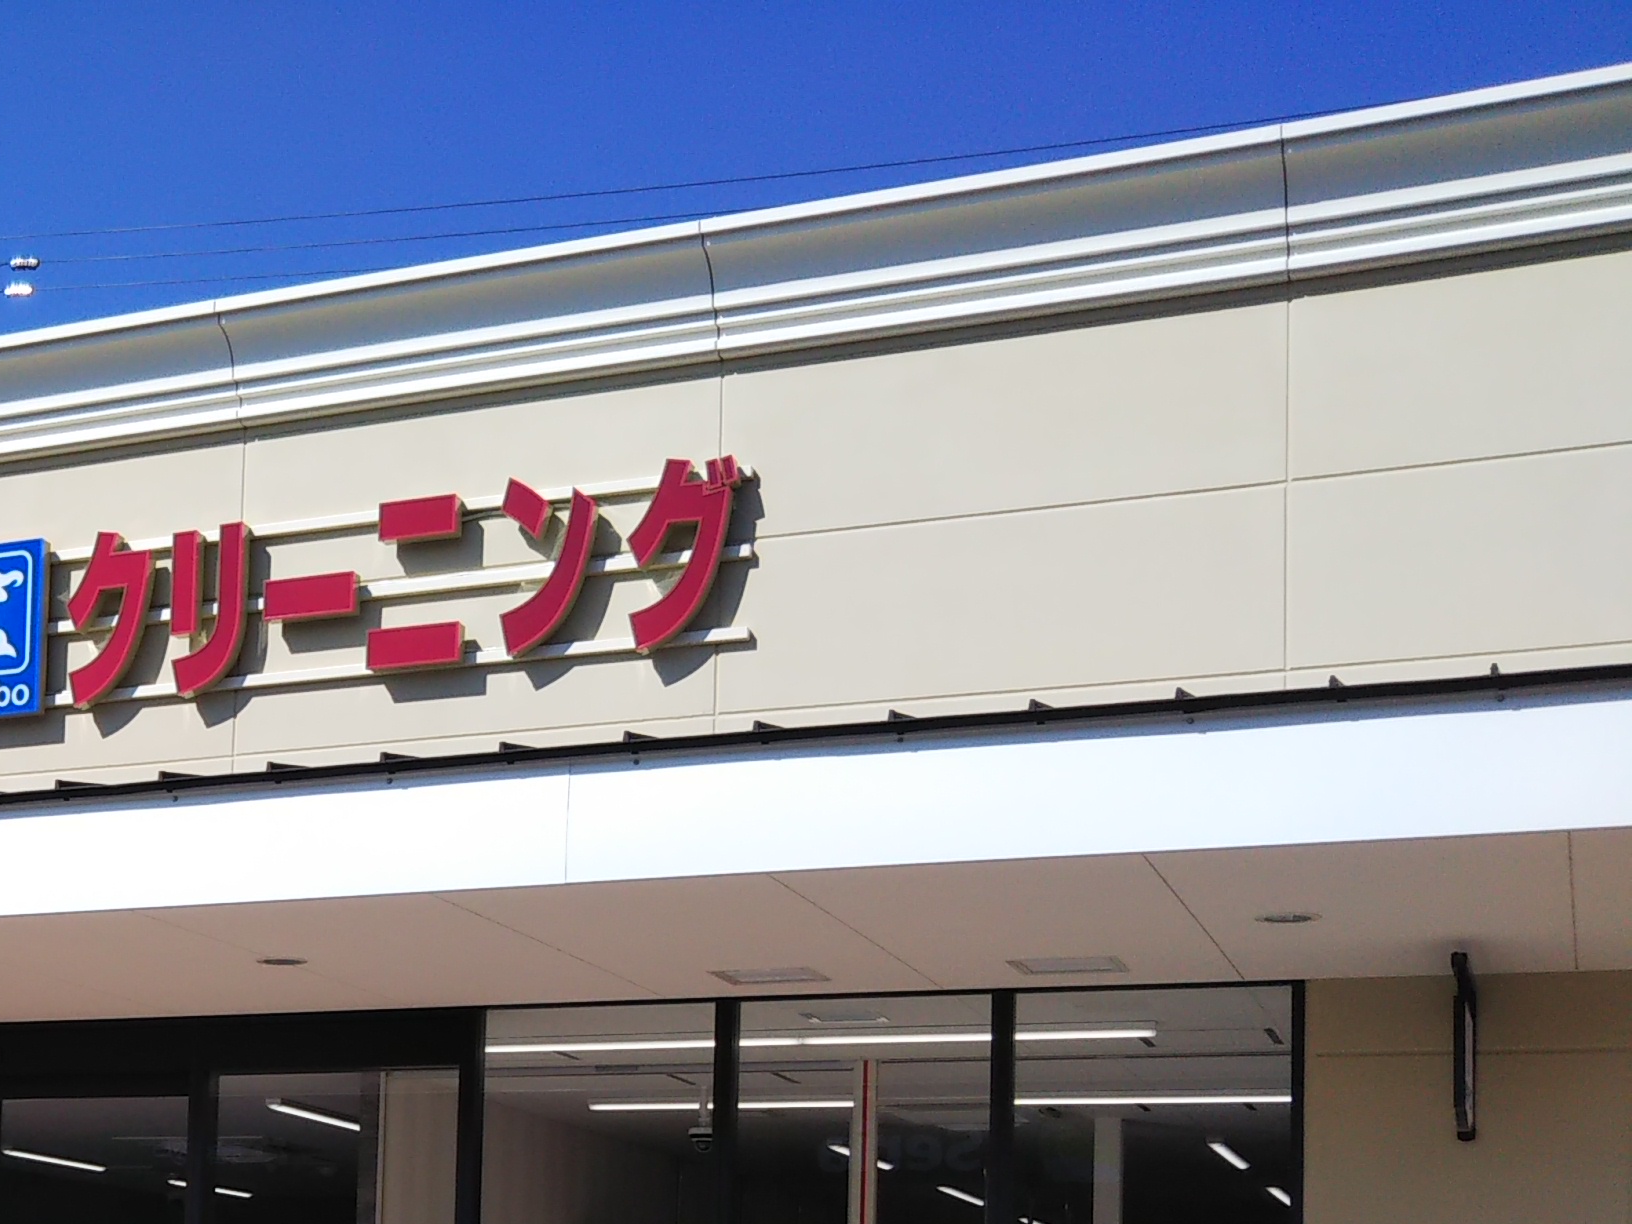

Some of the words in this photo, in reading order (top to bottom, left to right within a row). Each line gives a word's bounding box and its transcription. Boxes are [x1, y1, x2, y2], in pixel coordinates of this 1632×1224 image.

[68, 454, 742, 709] クリーニング
